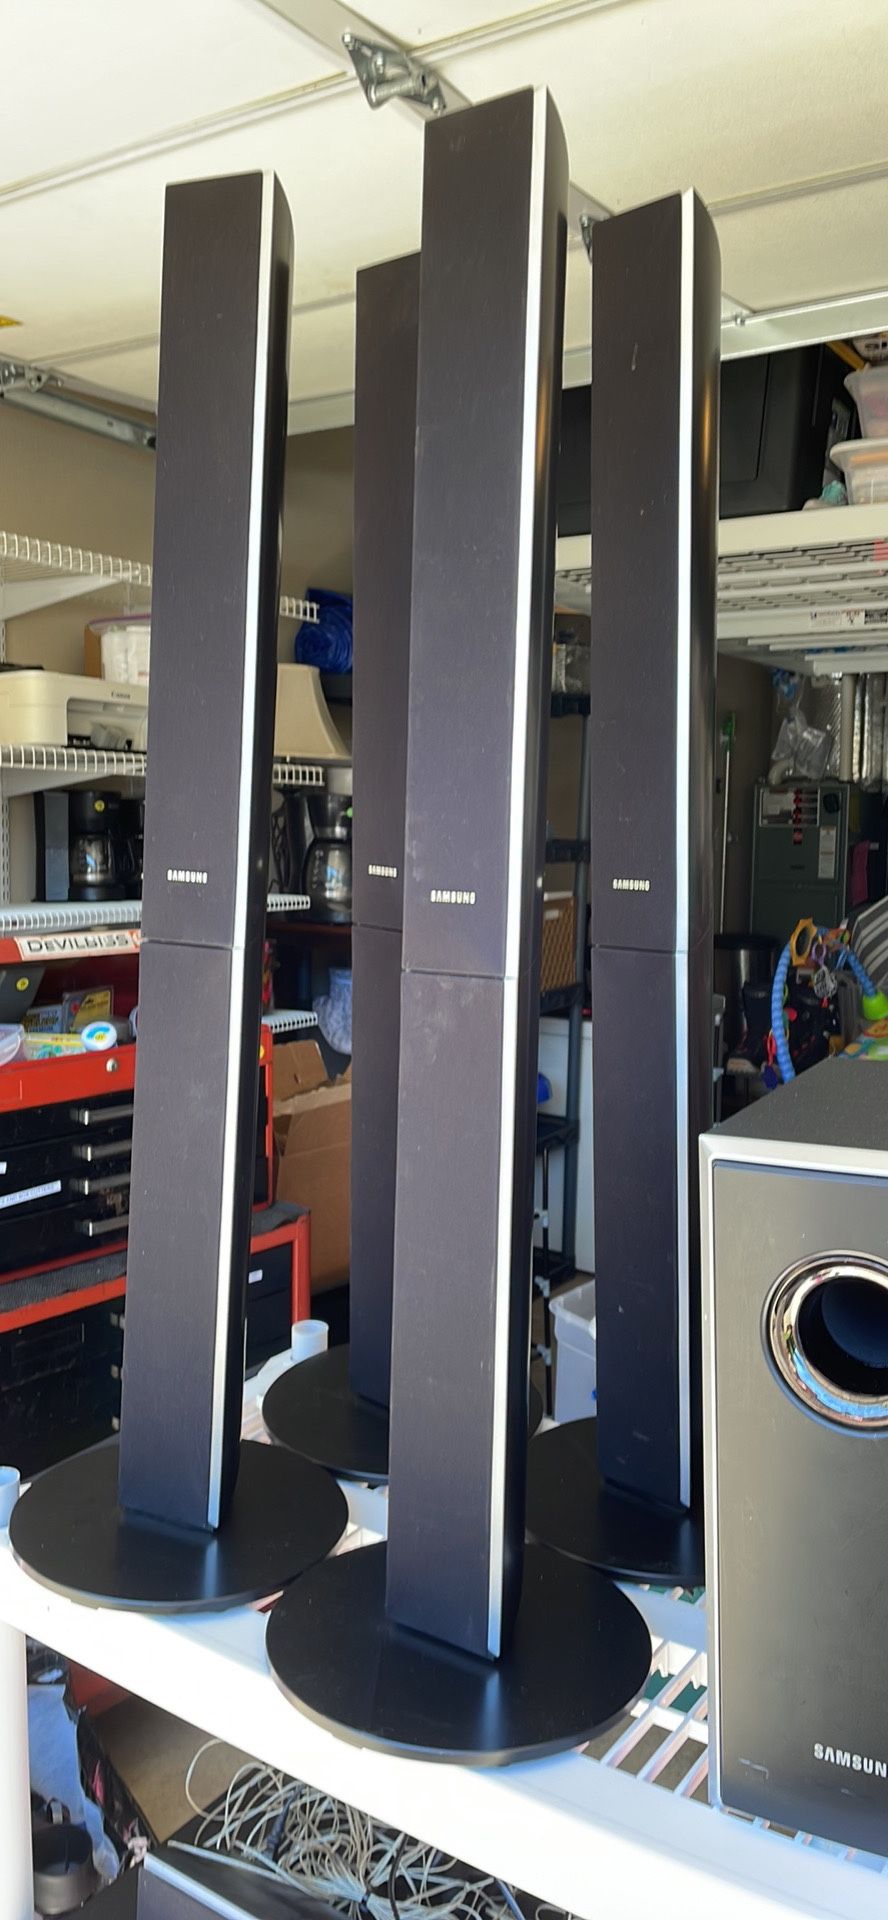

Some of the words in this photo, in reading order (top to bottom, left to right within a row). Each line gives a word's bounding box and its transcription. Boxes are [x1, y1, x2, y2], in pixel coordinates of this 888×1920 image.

[167, 869, 208, 884] SAMSUNG
[368, 864, 398, 878] SAMSUNG
[612, 878, 650, 892] SAMSUNG
[430, 889, 476, 905] SAMSUNG
